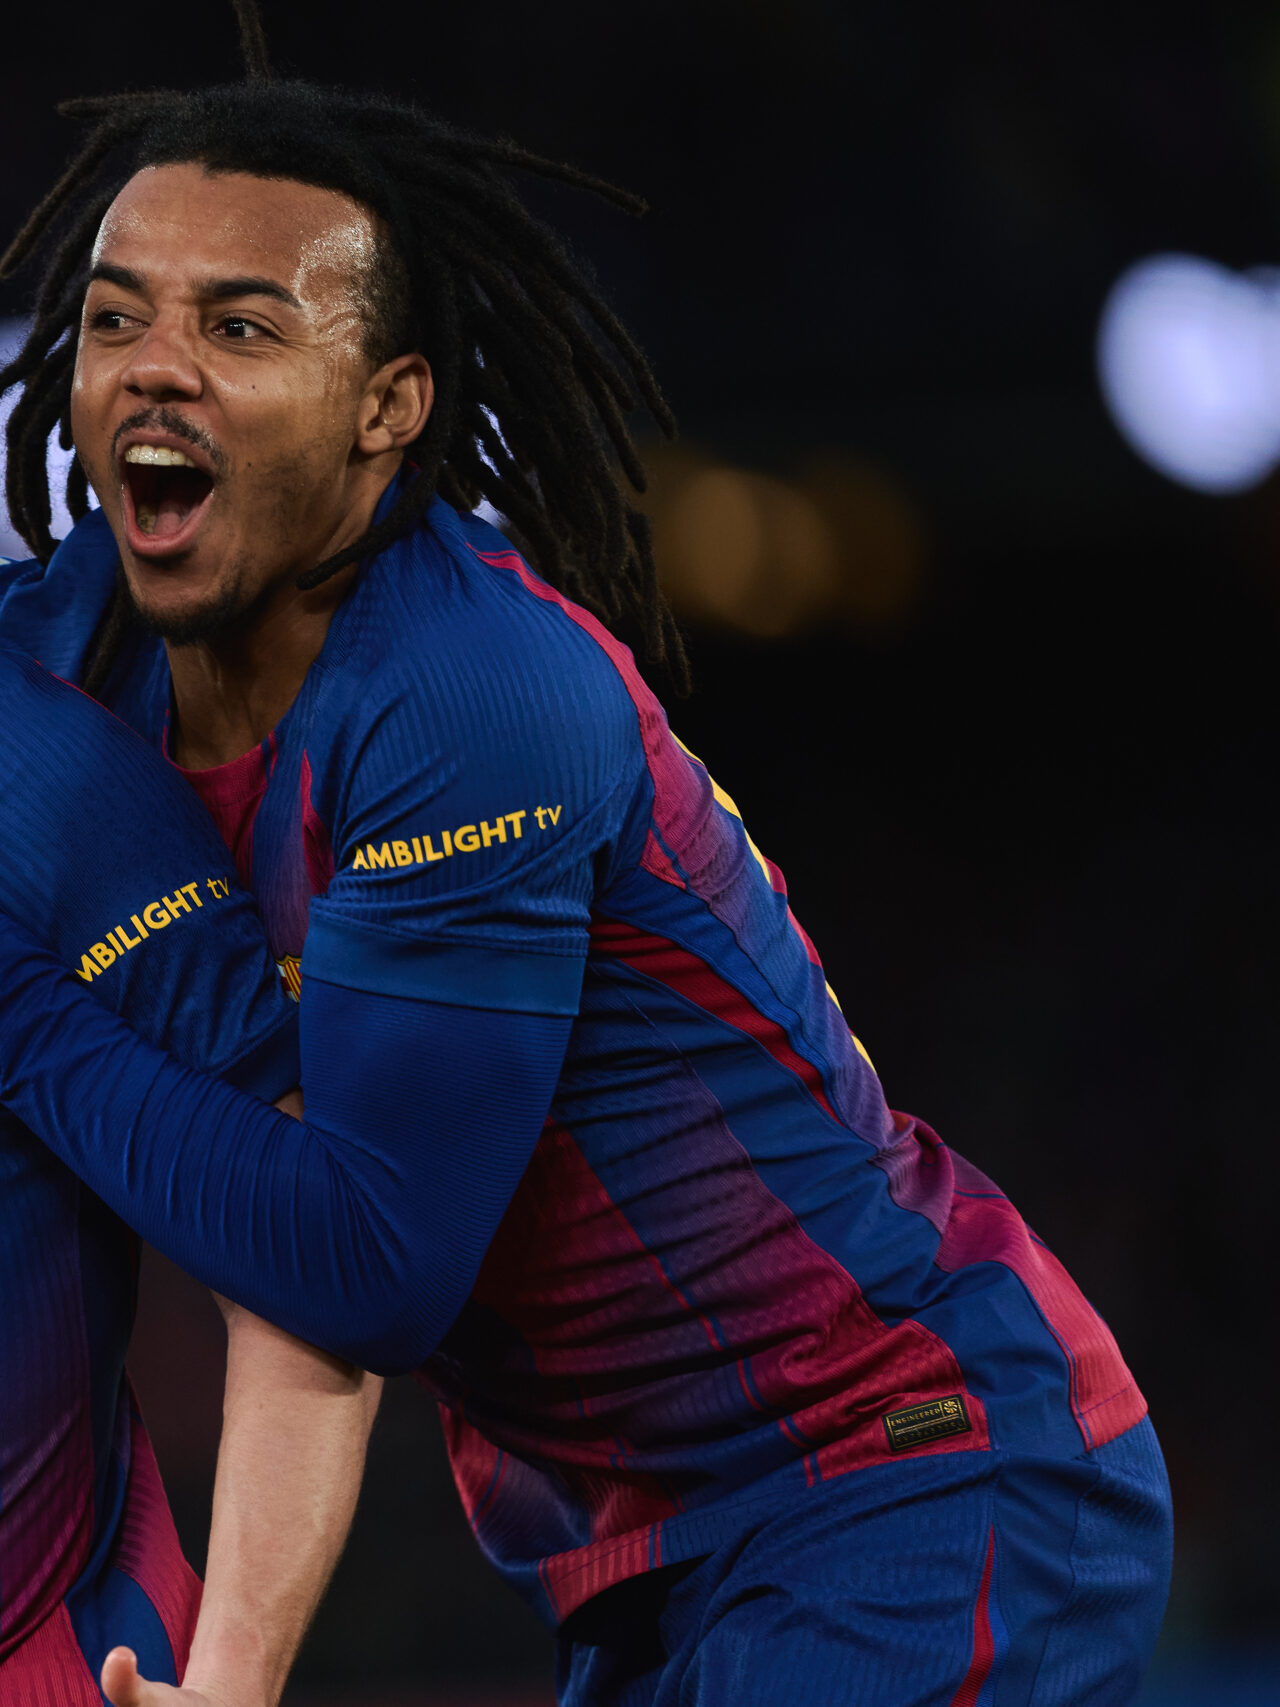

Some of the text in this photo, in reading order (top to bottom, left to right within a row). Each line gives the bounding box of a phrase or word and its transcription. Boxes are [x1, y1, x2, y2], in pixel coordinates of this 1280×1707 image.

[352, 805, 562, 870] AMBILIGHT tv
[74, 877, 230, 983] MBILIGHT tv
